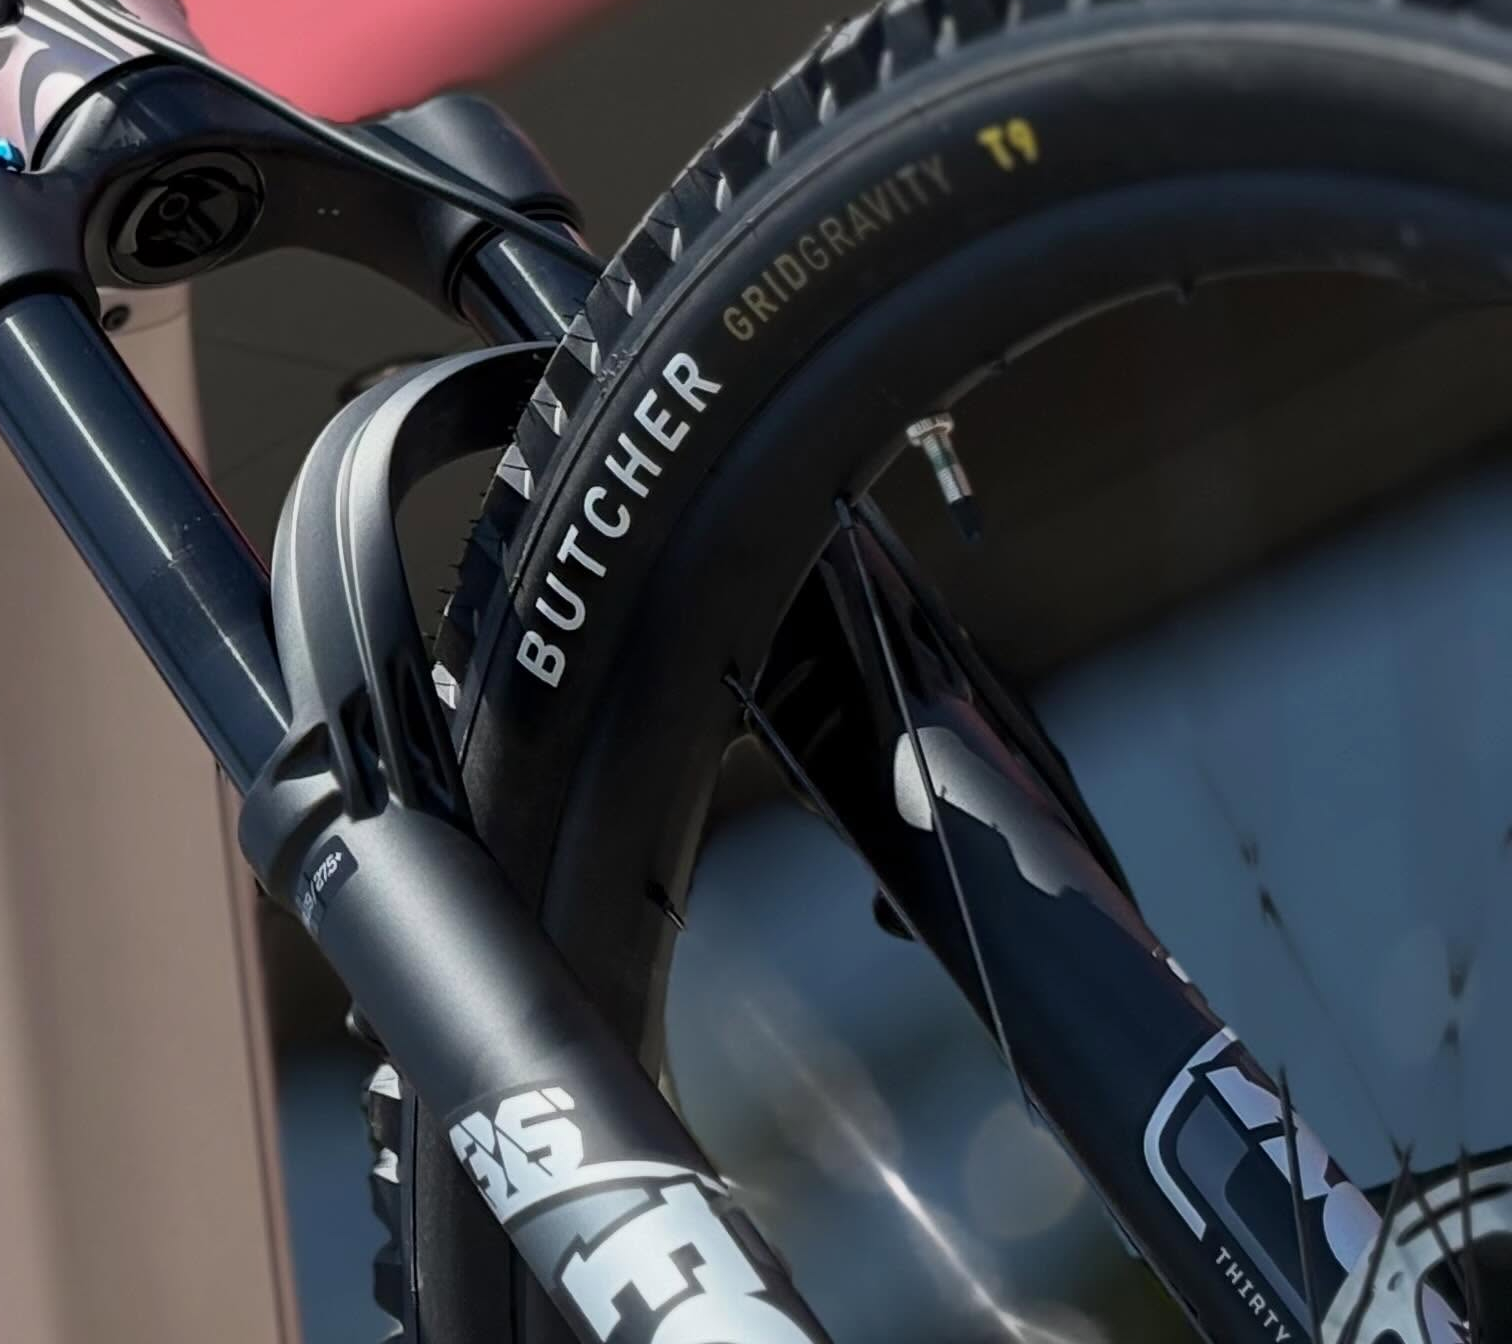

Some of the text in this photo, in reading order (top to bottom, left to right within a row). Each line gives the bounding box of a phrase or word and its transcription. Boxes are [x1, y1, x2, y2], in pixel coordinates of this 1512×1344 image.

[515, 352, 724, 688] BUTCHER
[723, 157, 951, 342] GRIDGRAVITY
[1215, 1245, 1291, 1344] THIRTY
